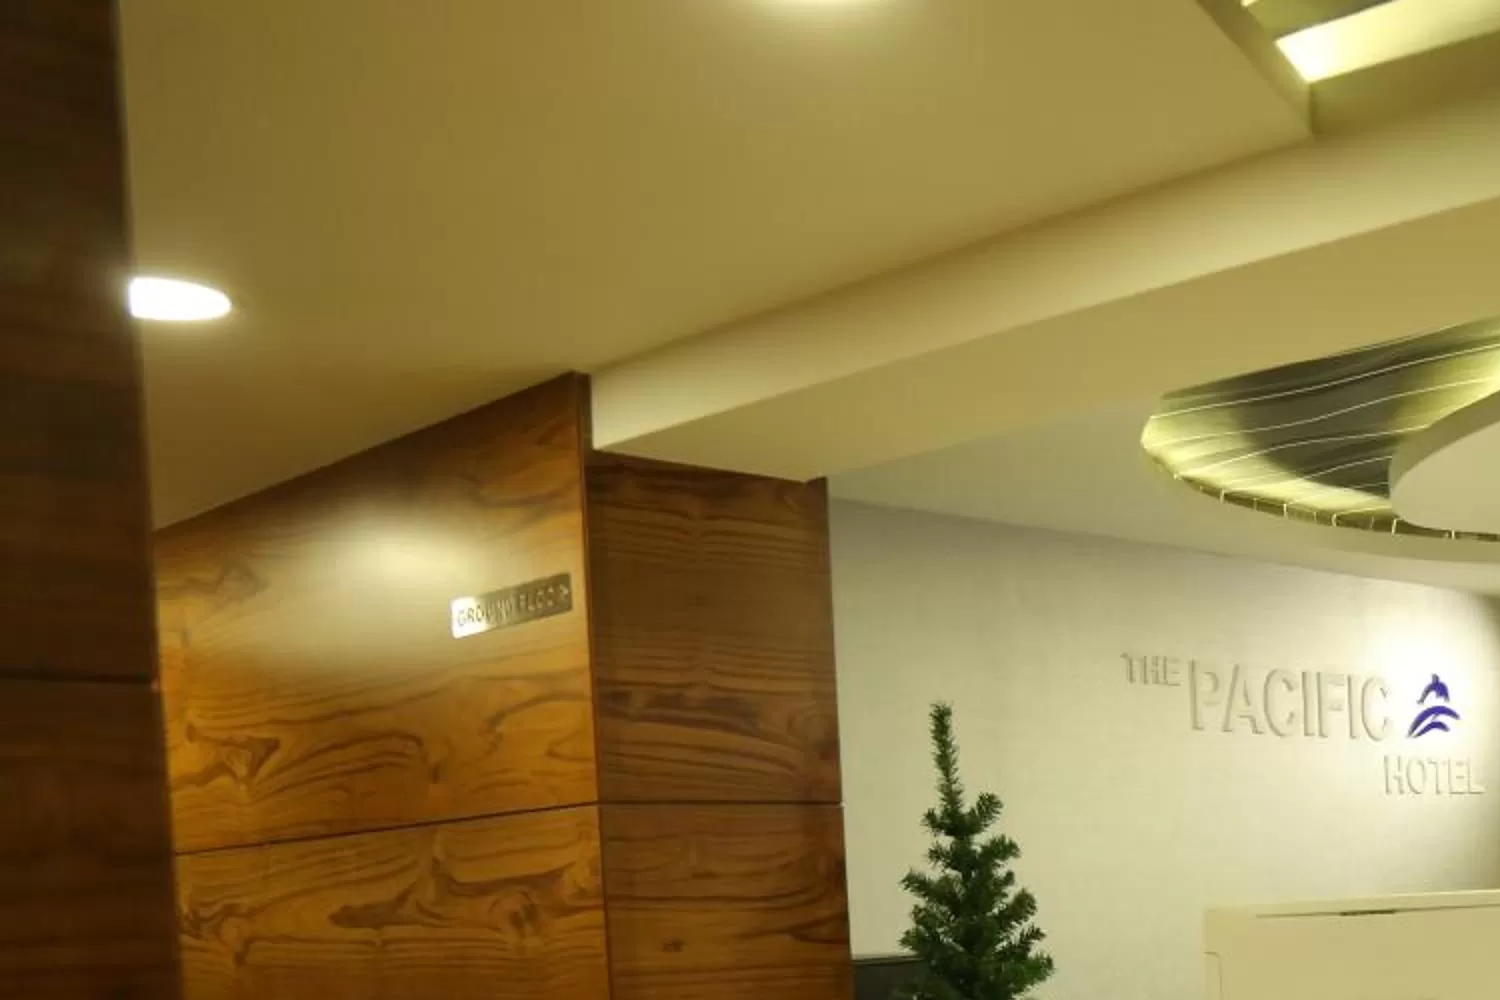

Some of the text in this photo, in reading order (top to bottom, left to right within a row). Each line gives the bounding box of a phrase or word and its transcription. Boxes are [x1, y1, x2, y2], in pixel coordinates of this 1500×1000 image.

[457, 593, 514, 628] GROUND
[1120, 652, 1391, 742] THE PACIFIC
[1383, 754, 1485, 795] HOTEL
